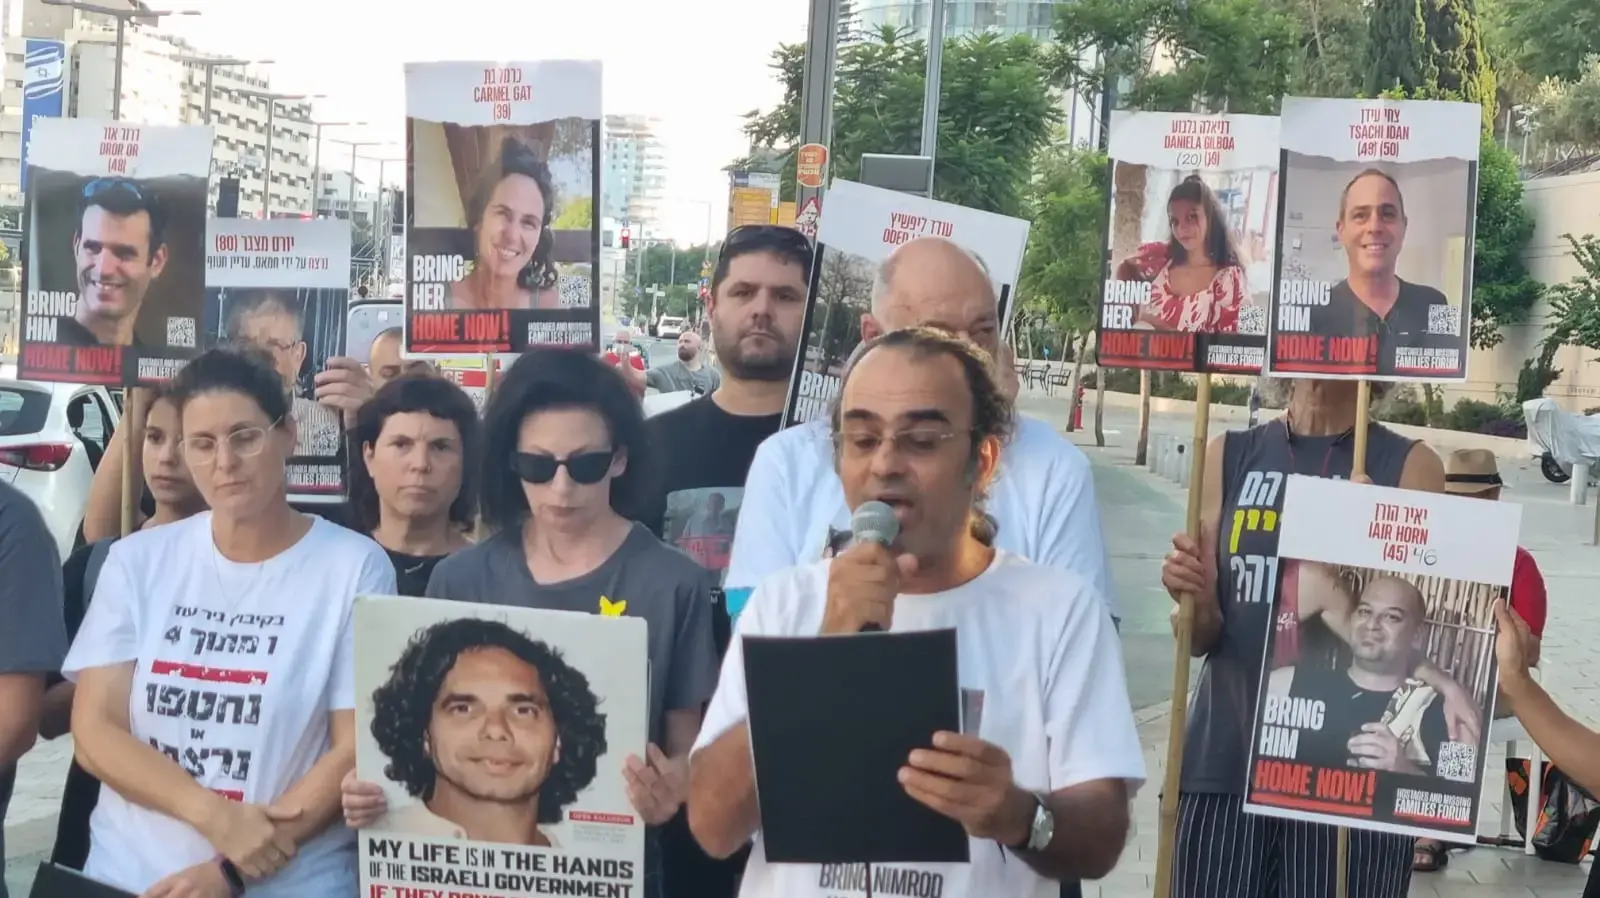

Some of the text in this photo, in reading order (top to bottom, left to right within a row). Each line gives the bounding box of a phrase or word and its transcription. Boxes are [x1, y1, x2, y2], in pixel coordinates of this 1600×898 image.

[500, 68, 522, 83] כרמל
[474, 85, 532, 103] CARMEL GAT
[493, 103, 512, 121] (39)
[1360, 108, 1400, 124] צחי עידן
[104, 126, 140, 141] דרור אור
[1172, 119, 1230, 134] דניאלה גלבוע
[1349, 124, 1409, 141] TSACHI IDAN
[99, 142, 139, 157] DROR OR
[1164, 135, 1235, 151] DANIELA GILBOA
[1379, 141, 1400, 158] (50)
[1176, 152, 1202, 167] (20)
[891, 211, 953, 238] עודד ליפשיץ
[215, 233, 238, 253] (80)
[272, 235, 295, 252] יורם
[207, 255, 227, 269] חטוף
[281, 256, 293, 270] ידי
[296, 255, 306, 270] על
[412, 254, 464, 282] BRING
[27, 290, 77, 317] BRING
[412, 283, 445, 311] HER
[1104, 279, 1151, 305] BRING
[1279, 279, 1331, 306] BRING
[26, 316, 57, 342] HIM
[412, 310, 510, 341] HOME NOW!
[1102, 304, 1133, 330] HER
[1278, 304, 1311, 332] HIM
[528, 331, 563, 345] FAMILIES
[1101, 332, 1194, 361] HOME NOW!
[1276, 333, 1378, 363] HOME NOW!
[24, 346, 122, 374] HOME NOW!
[1207, 352, 1264, 367] FAMILIES FORUM
[1395, 355, 1459, 370] FAMILIES FORUM
[799, 370, 840, 401] BRIN
[1237, 471, 1283, 507] הם
[1375, 503, 1428, 525] יאיר הורן
[1229, 509, 1278, 554] יין
[1368, 522, 1429, 546] IAIR HORN
[1383, 543, 1409, 564] (45)
[1412, 547, 1438, 566] 46
[174, 605, 285, 629] בקיבוץ ניר עוז
[164, 625, 183, 645] 4
[190, 627, 260, 655] מתוך
[146, 682, 262, 725] נחטפו
[1264, 696, 1326, 731] BRING
[190, 728, 205, 740] או
[1259, 725, 1300, 760] HIM
[149, 737, 251, 781] נרצ
[1255, 760, 1376, 805] HOME NOW!
[1395, 798, 1471, 822] FAMILIES FORUM
[1429, 792, 1443, 804] AND
[368, 837, 634, 879] MY LIFE IS IN THE HANDS
[369, 861, 633, 898] OF THE ISRAELI GOVERNMENT
[873, 866, 944, 898] NIMROD
